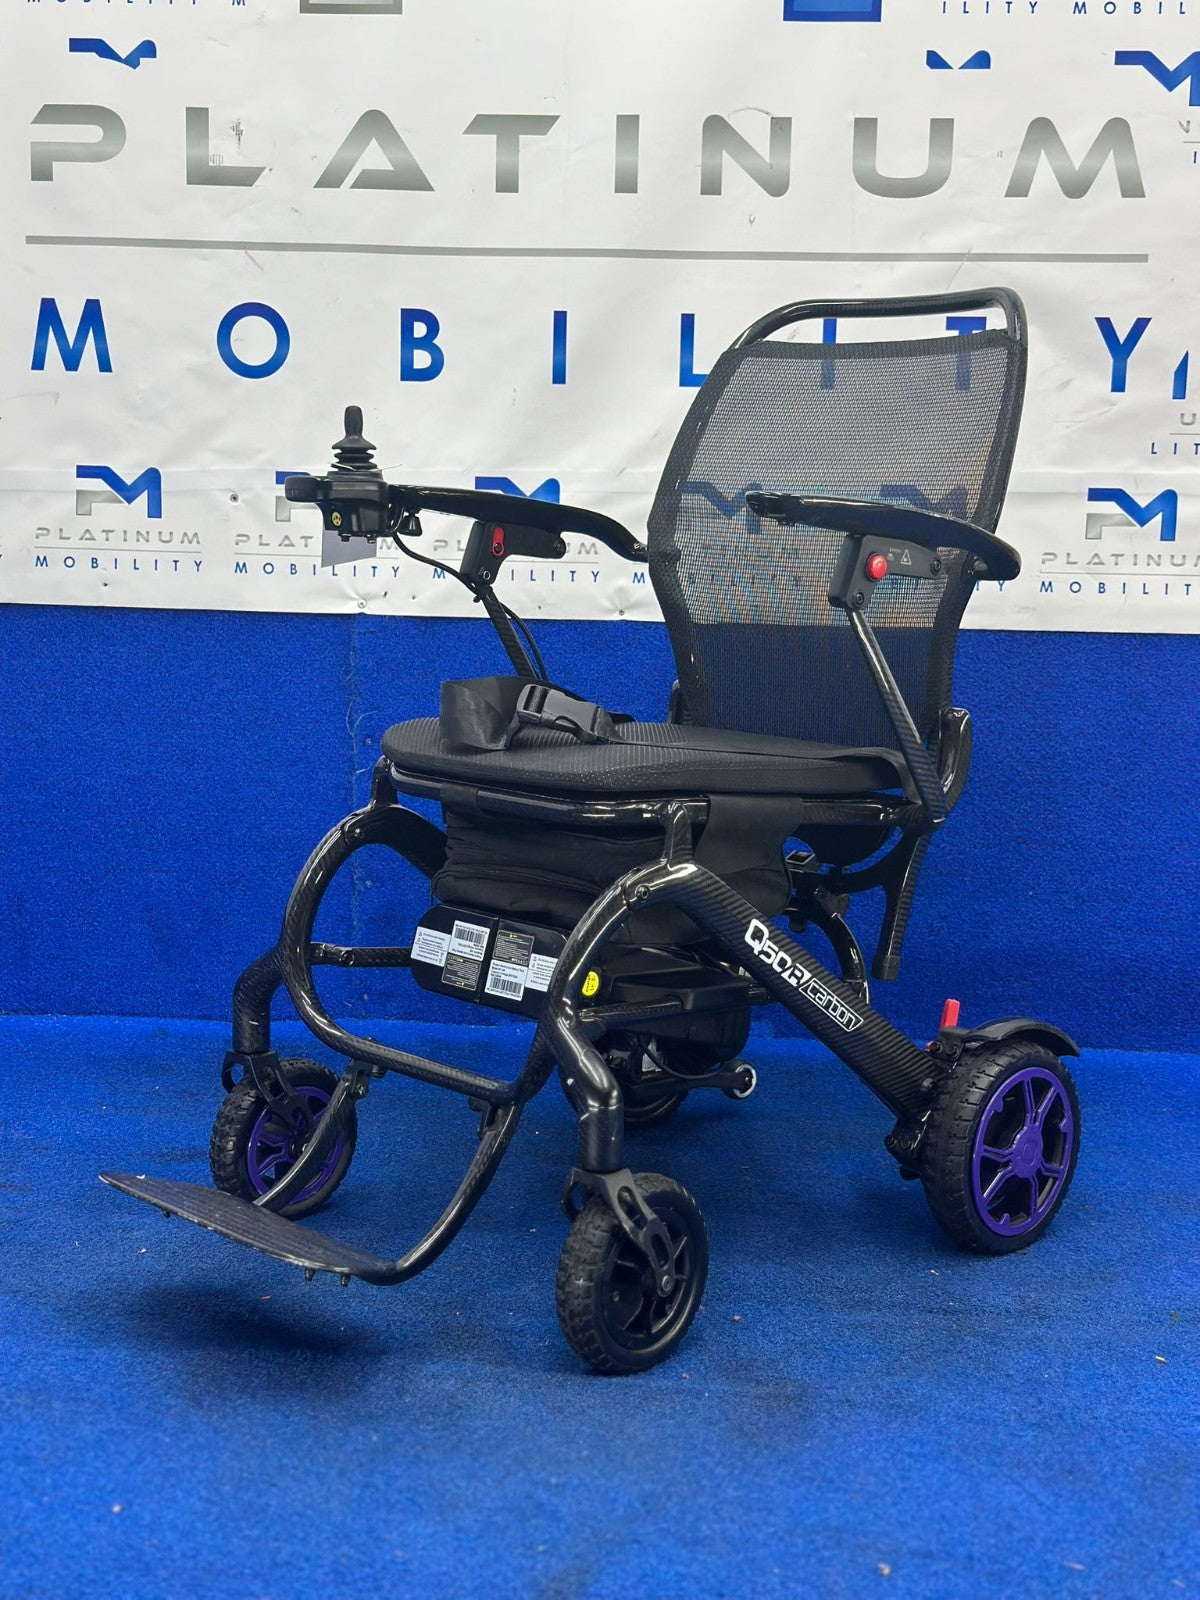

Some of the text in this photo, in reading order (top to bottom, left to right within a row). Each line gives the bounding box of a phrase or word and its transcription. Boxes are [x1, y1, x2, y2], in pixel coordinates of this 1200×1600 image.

[30, 104, 1146, 199] PLATINUM
[31, 298, 1153, 393] MOBILITY
[35, 527, 201, 544] PLATINUM
[35, 555, 202, 572] MOBILITY
[234, 562, 400, 578] MOBILITY
